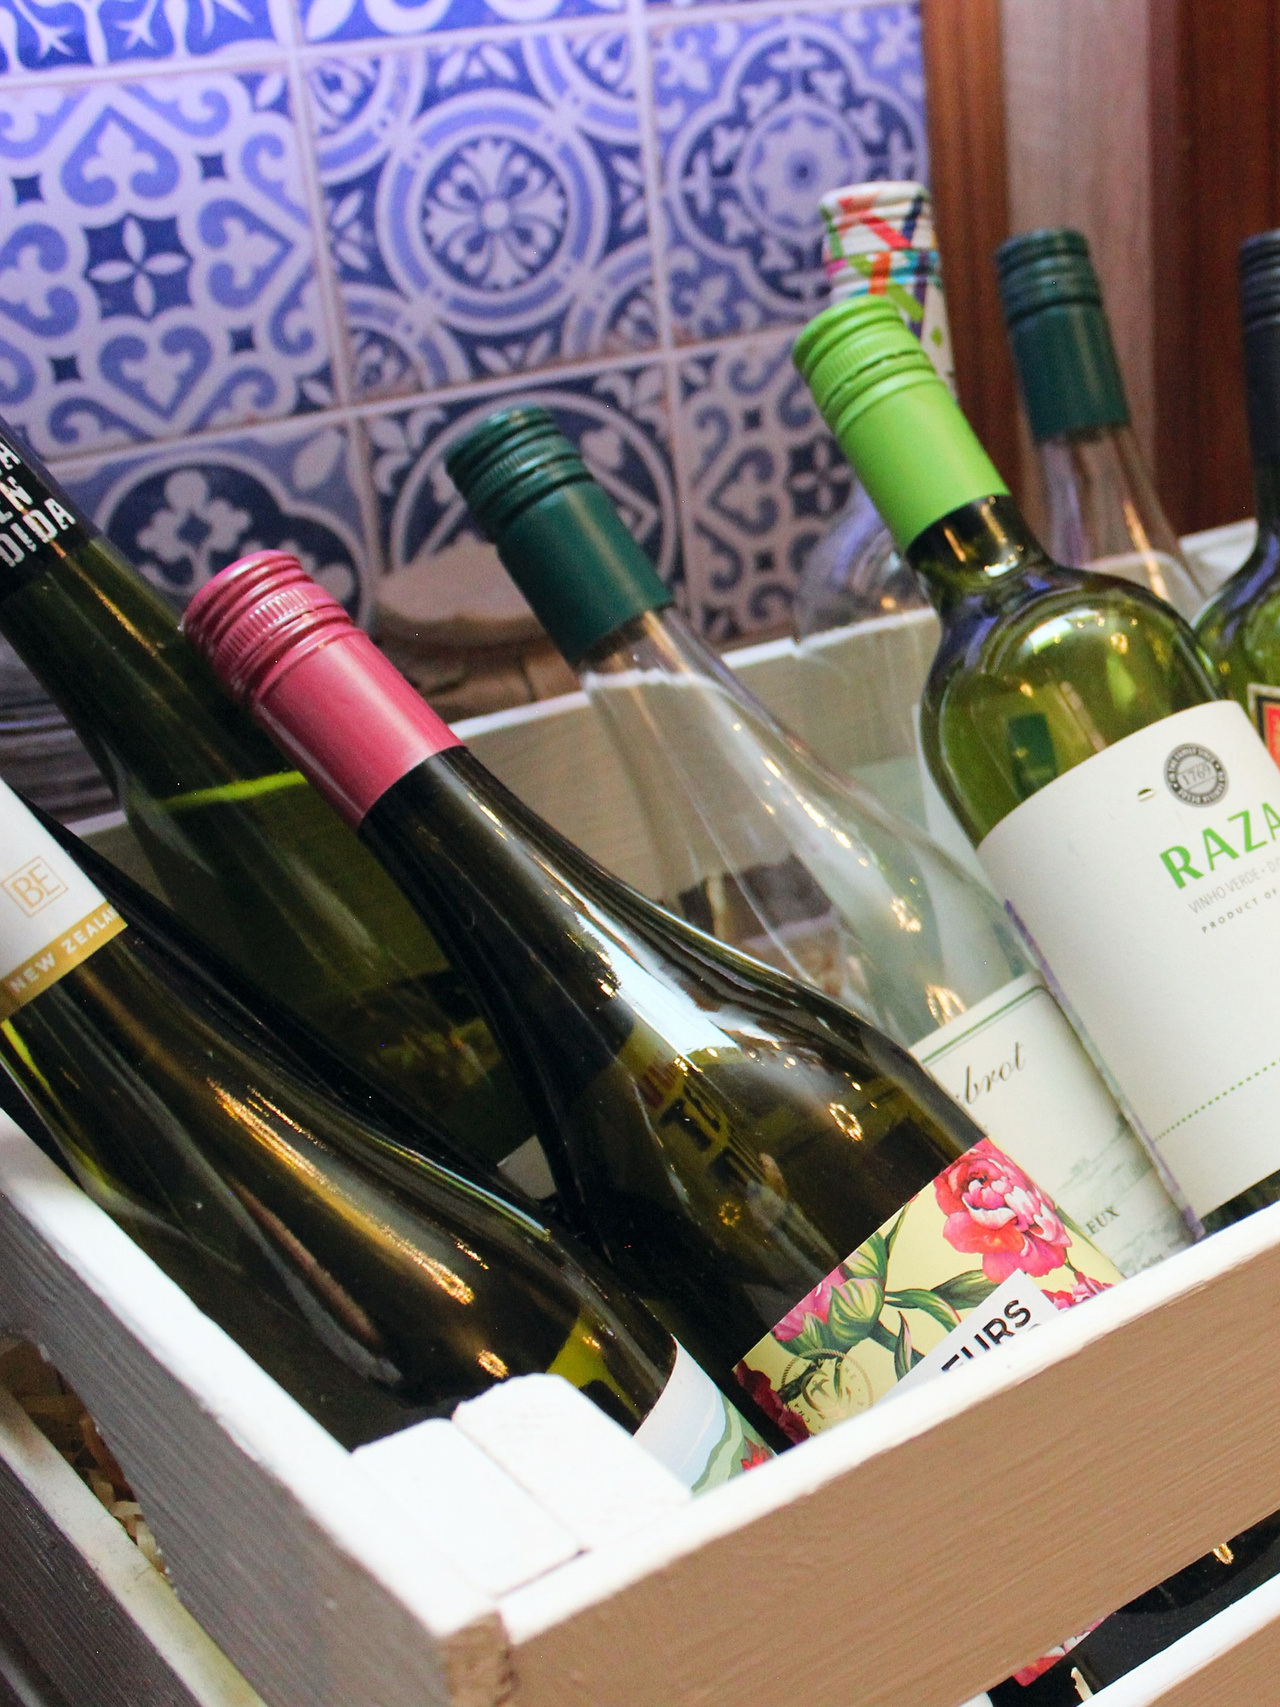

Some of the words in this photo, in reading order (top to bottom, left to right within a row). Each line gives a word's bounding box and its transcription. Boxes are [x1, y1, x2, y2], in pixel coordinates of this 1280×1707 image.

[12, 864, 60, 907] BE
[1188, 886, 1226, 914] VINHO
[1225, 868, 1261, 893] VERDE
[1201, 898, 1259, 934] PRODUCT
[1264, 888, 1277, 899] OF
[9, 952, 56, 993] NEW
[956, 1041, 1025, 1105] brot
[1085, 1205, 1120, 1238] EUX
